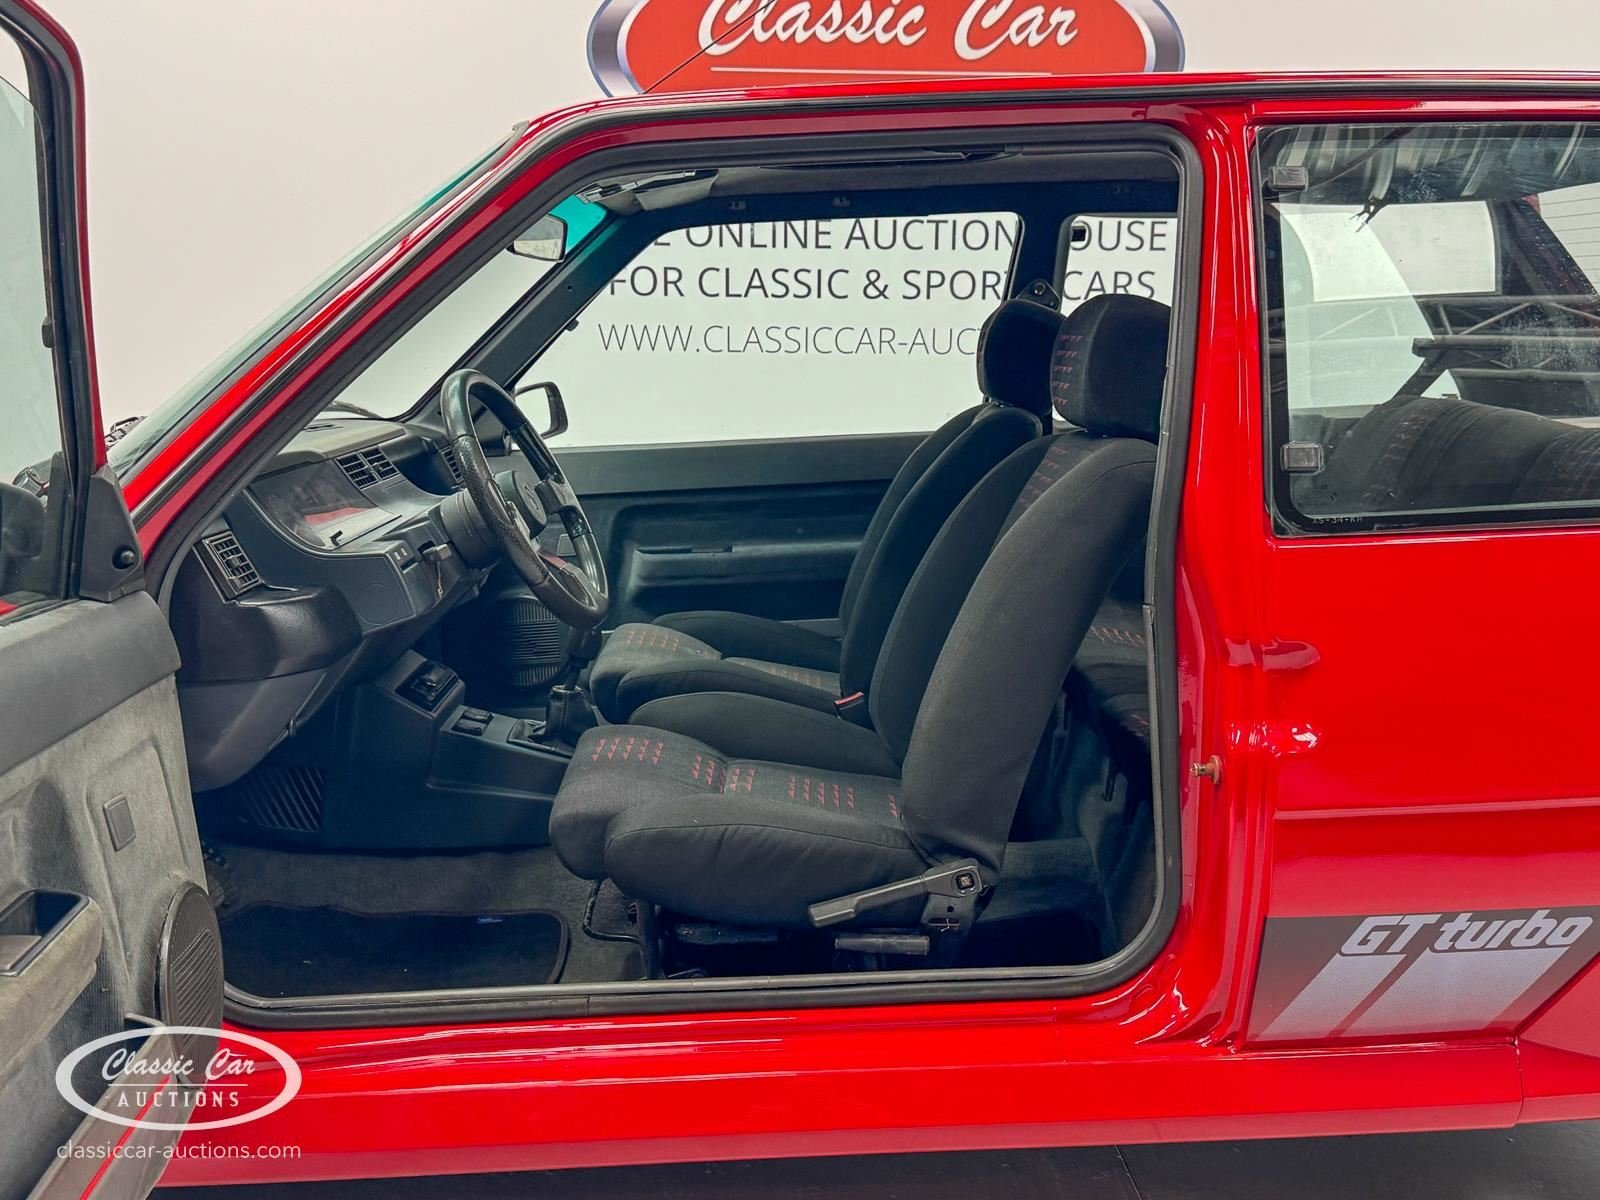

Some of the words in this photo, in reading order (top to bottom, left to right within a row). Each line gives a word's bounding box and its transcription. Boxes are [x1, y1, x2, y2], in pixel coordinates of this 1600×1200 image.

[698, 0, 927, 56] Classic
[954, 0, 1079, 61] Car
[685, 219, 832, 249] ONLINE
[844, 218, 1015, 251] AUCTION
[1070, 221, 1168, 251] OUSE
[698, 267, 850, 299] CLASSIC
[862, 269, 890, 300] &
[902, 269, 1008, 301] SPOR
[1063, 271, 1156, 301] CARS
[598, 323, 980, 355] WWW.CLASSICCAR-AUC
[1341, 913, 1443, 954] GT
[1433, 909, 1594, 951] turbo
